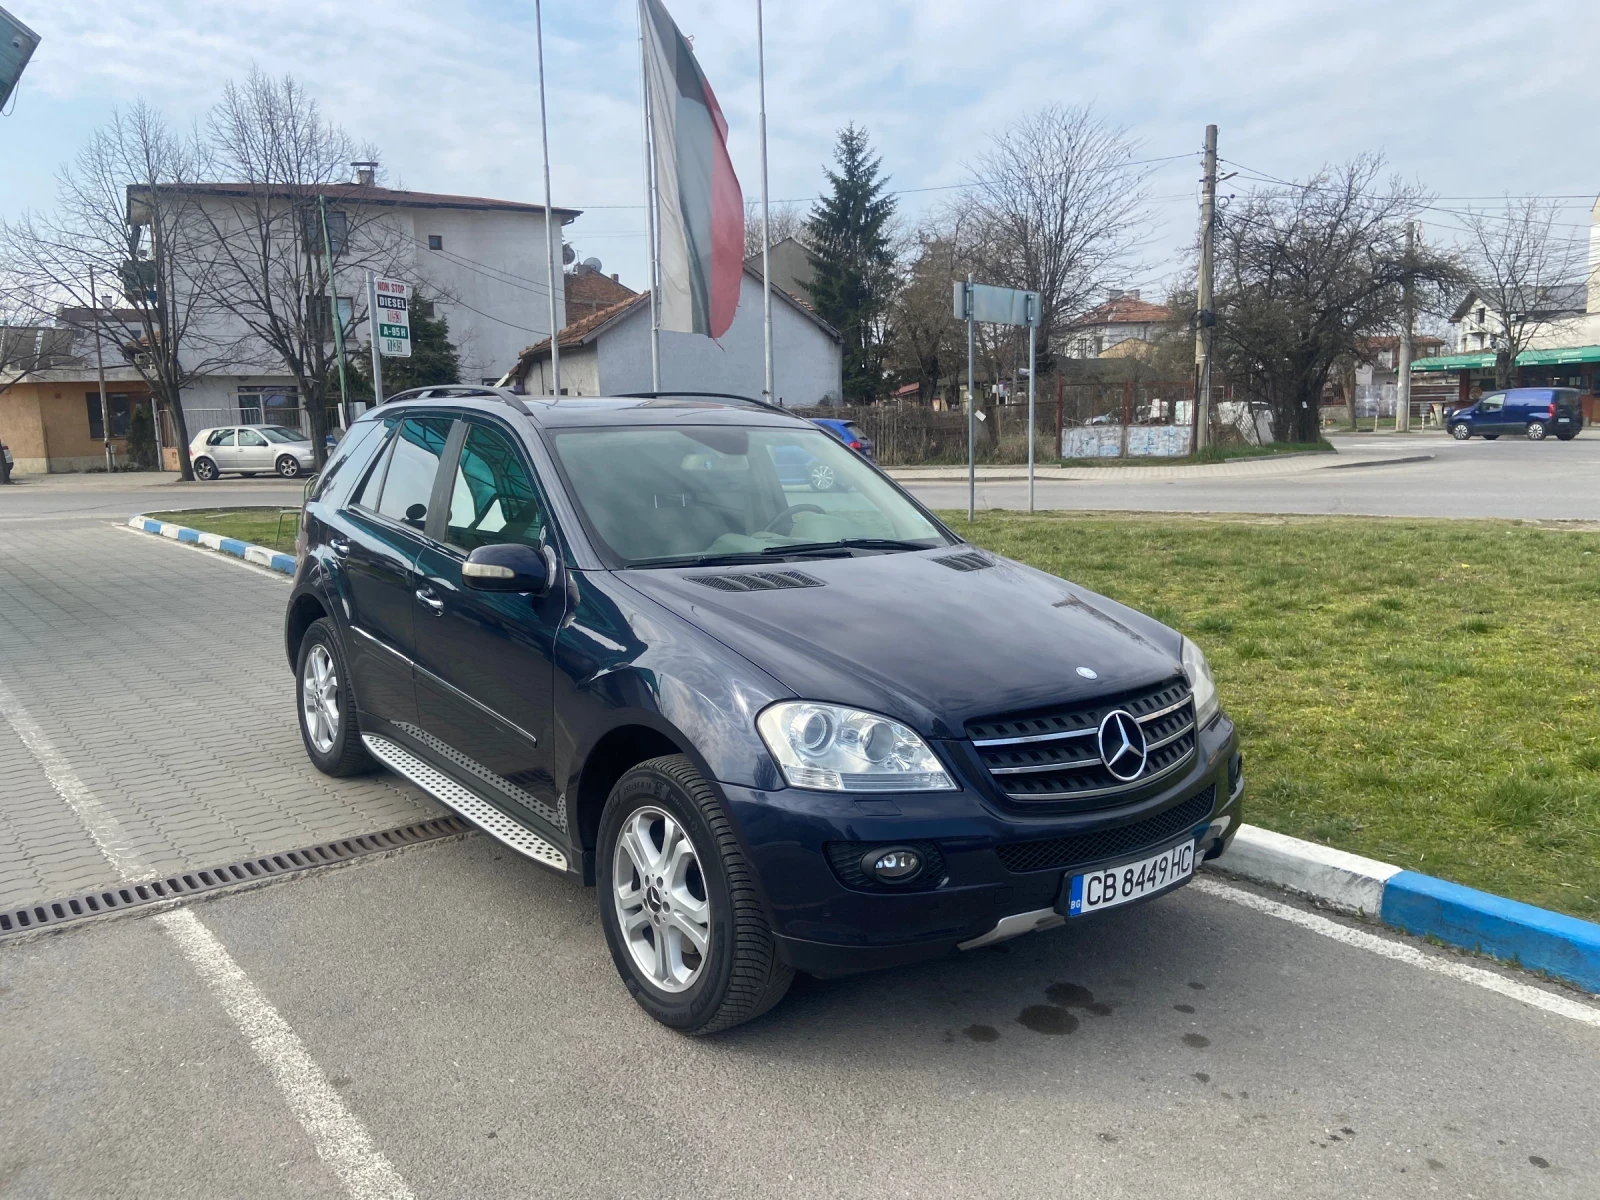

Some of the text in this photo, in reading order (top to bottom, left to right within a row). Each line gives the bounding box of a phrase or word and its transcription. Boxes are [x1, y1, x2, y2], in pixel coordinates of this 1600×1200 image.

[377, 281, 404, 294] NON STOP
[379, 297, 405, 308] DIESEL
[1087, 845, 1192, 906] CB 8449 HC
[1070, 900, 1081, 910] BG
